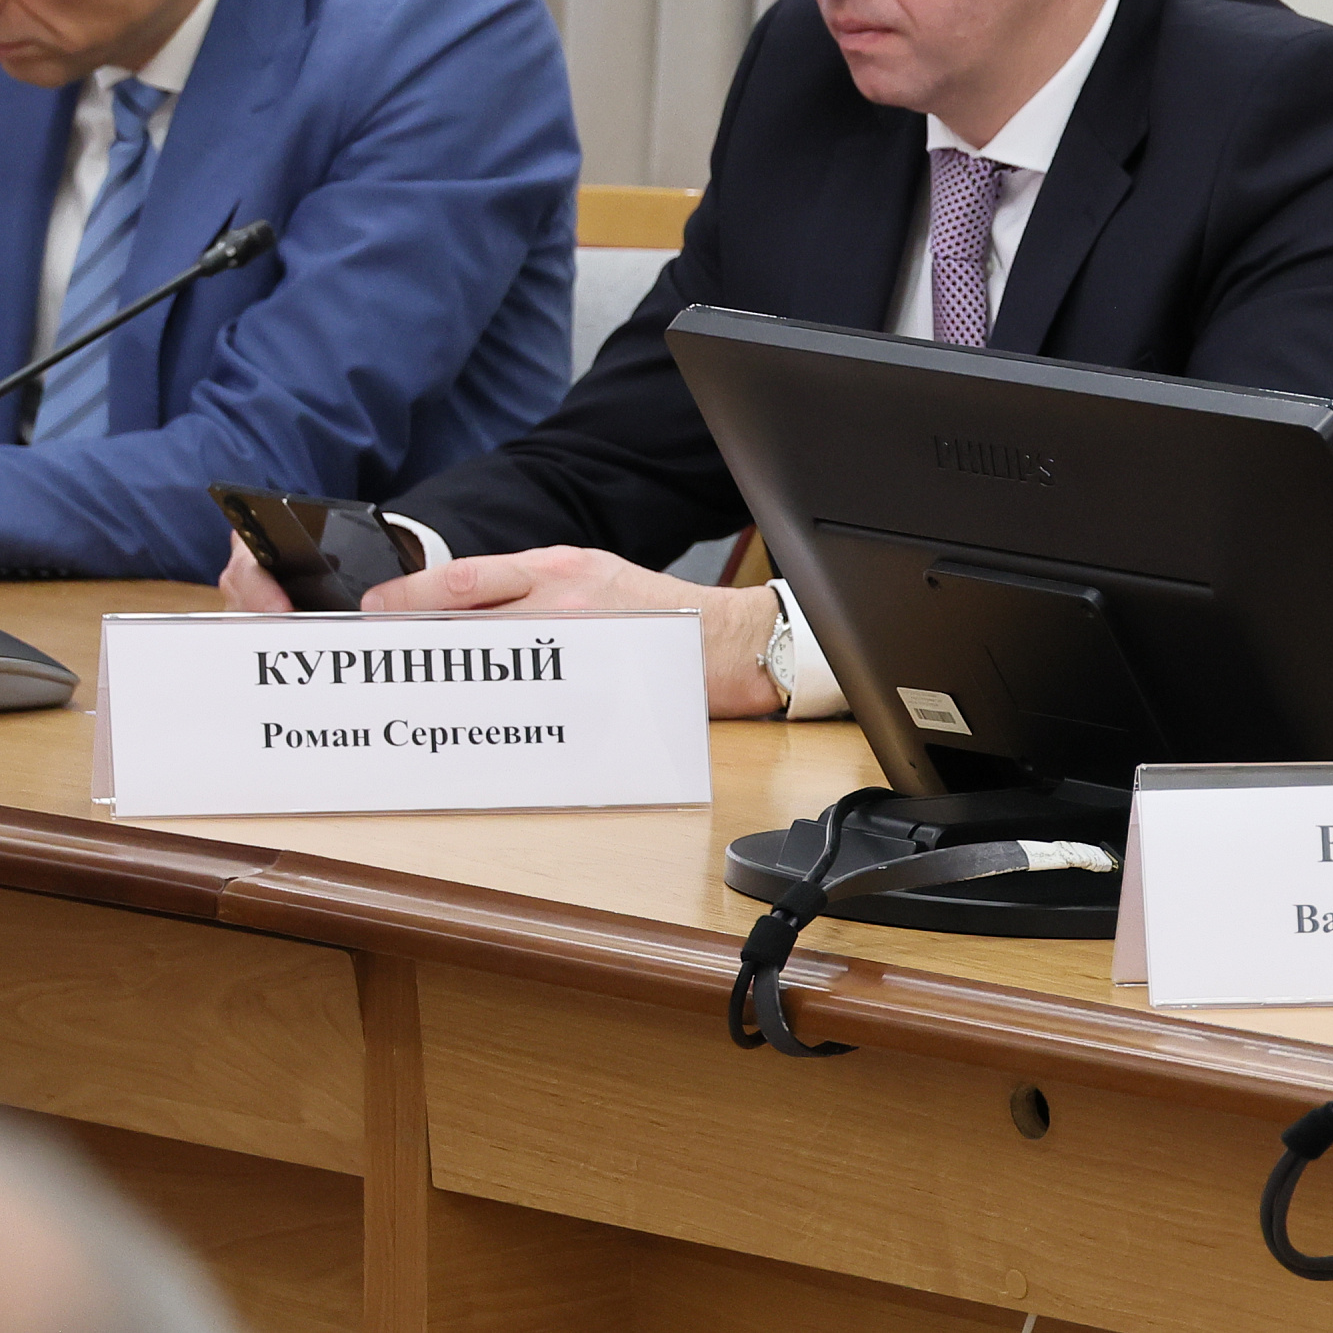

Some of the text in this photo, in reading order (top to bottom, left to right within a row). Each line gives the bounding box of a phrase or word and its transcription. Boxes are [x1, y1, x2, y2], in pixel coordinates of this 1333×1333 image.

[932, 434, 1057, 488] PHILIPS
[254, 637, 567, 686] КУРИННЫЙ
[261, 719, 566, 754] Роман Сергеевич
